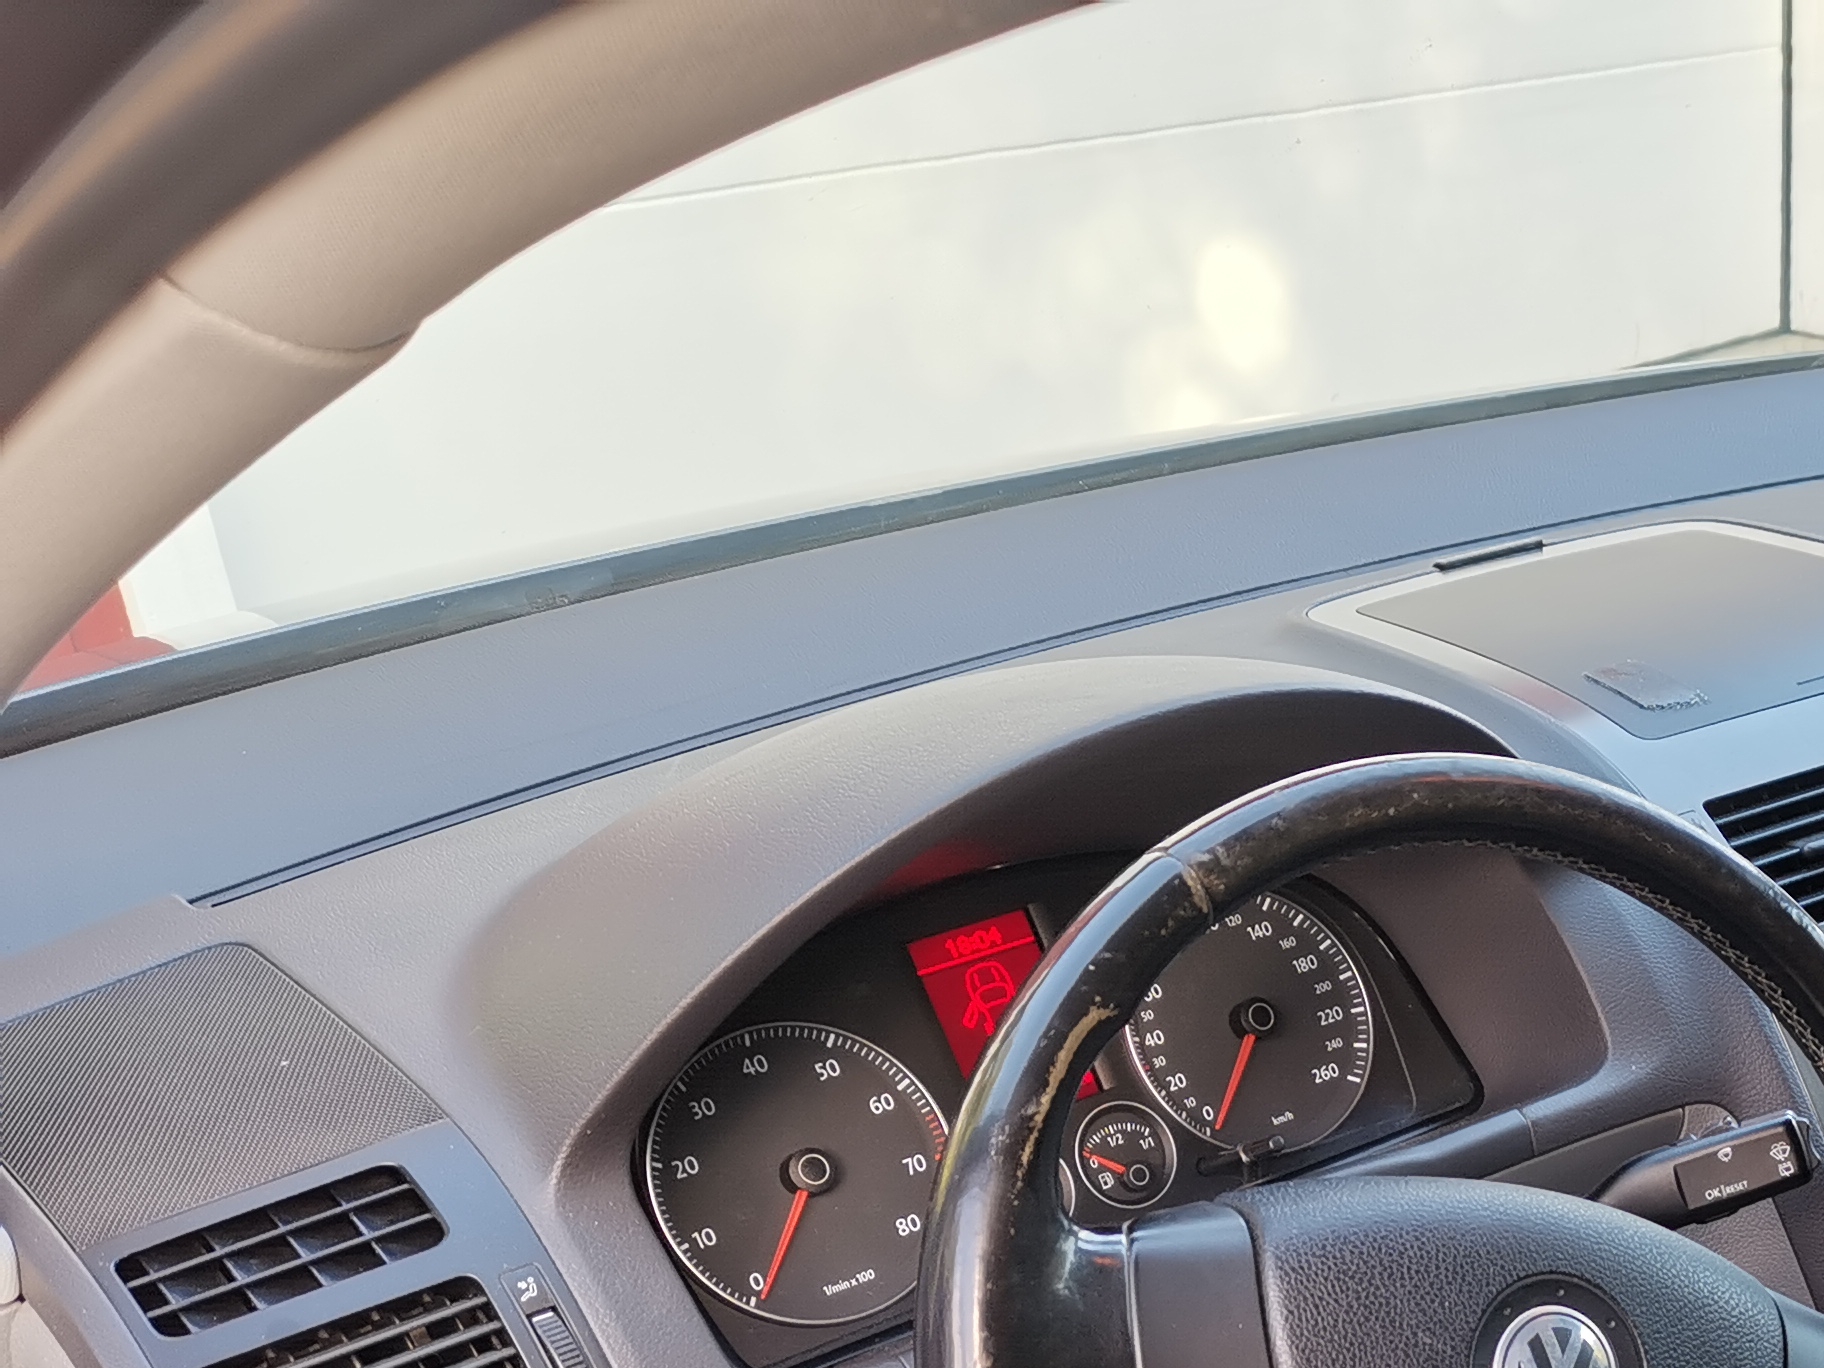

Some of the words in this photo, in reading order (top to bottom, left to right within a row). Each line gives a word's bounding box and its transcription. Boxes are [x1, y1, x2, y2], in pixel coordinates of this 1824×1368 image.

[1225, 913, 1242, 927] 120
[1247, 920, 1273, 941] 140
[1279, 935, 1297, 950] 160
[1292, 954, 1318, 974] 180
[1314, 980, 1332, 995] 200
[1141, 1009, 1154, 1022] 50
[1317, 1006, 1343, 1026] 220
[1144, 1029, 1165, 1047] 40
[1325, 1037, 1343, 1052] 240
[742, 1054, 769, 1076] 40
[815, 1059, 841, 1081] 50
[1153, 1055, 1166, 1069] 30
[1165, 1073, 1187, 1092] 20
[1311, 1063, 1339, 1084] 260
[688, 1098, 716, 1120] 30
[869, 1093, 895, 1116] 60
[1183, 1097, 1196, 1109] 10
[1202, 1106, 1214, 1120] 0
[1272, 1111, 1295, 1126] km/h
[1107, 1133, 1124, 1148] 1/2
[1139, 1136, 1155, 1150] 1/1
[672, 1156, 699, 1179] 20
[902, 1154, 927, 1176] 70
[895, 1214, 922, 1236] 80
[693, 1227, 717, 1249] 10
[749, 1272, 764, 1291] 0
